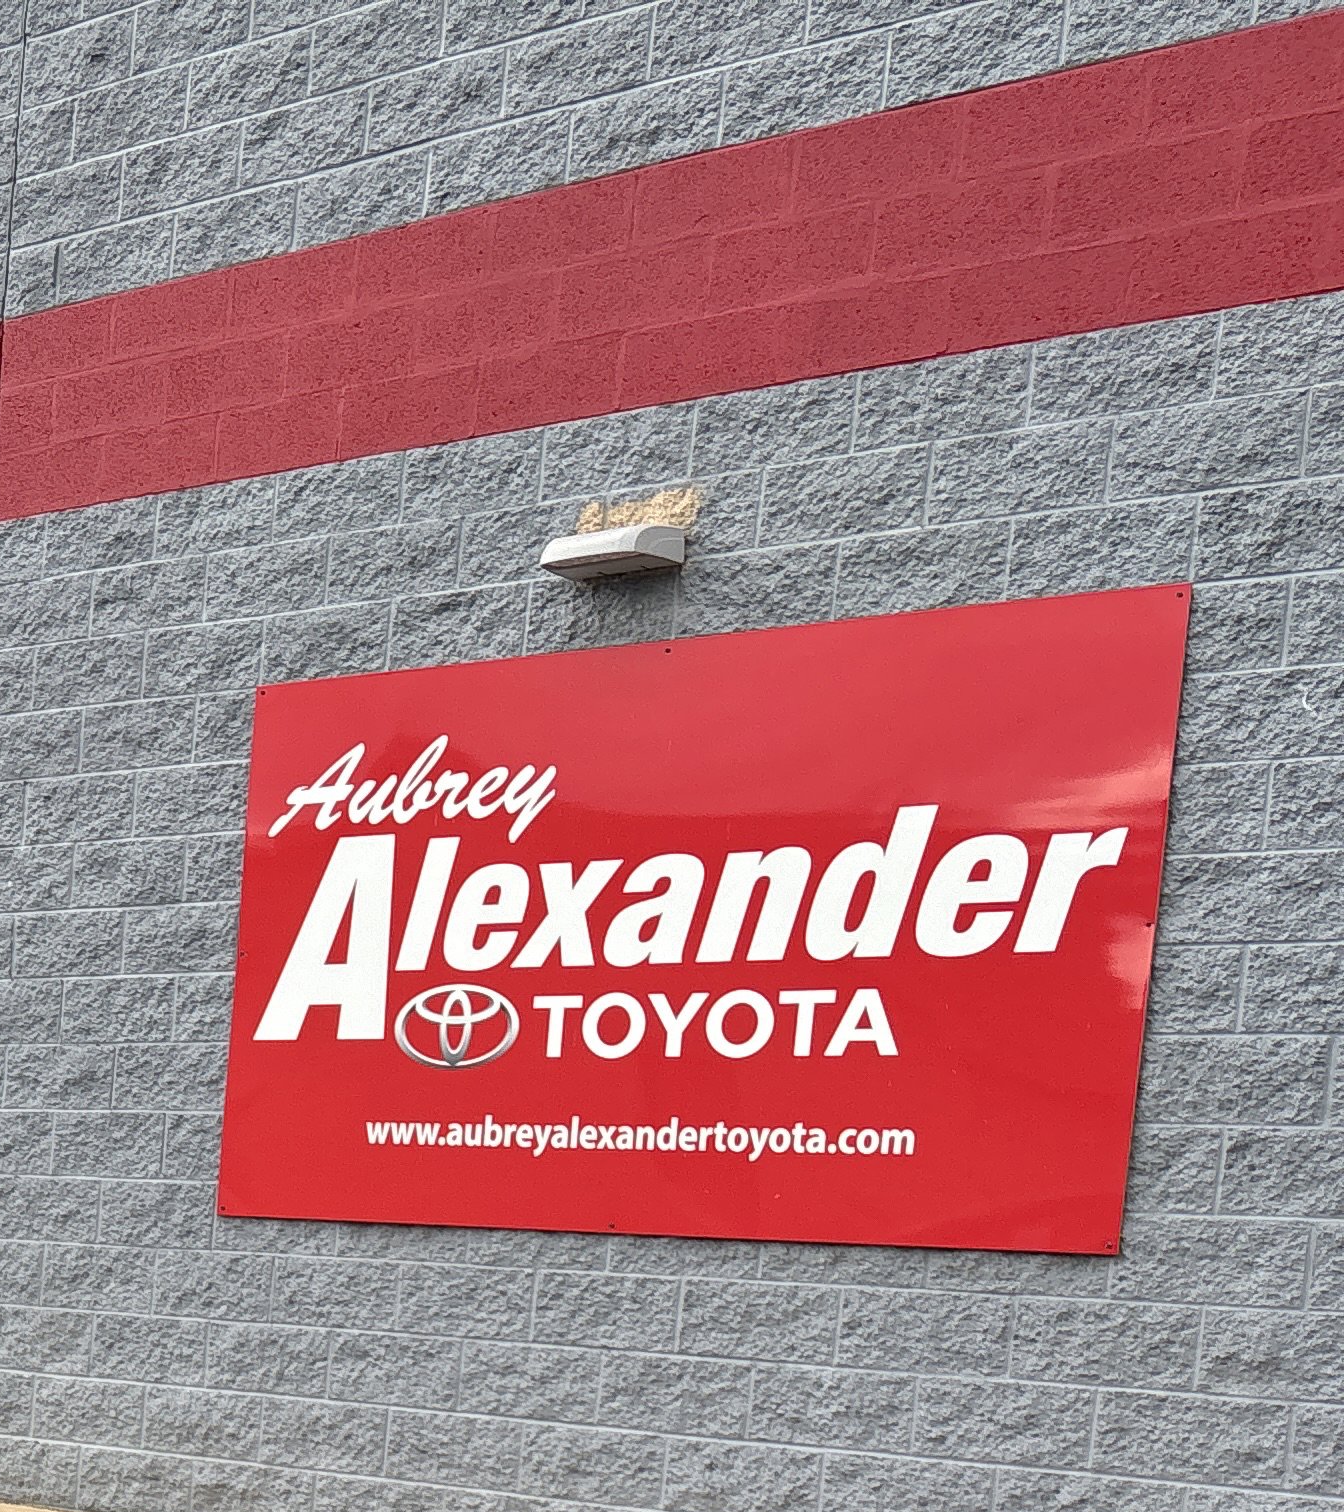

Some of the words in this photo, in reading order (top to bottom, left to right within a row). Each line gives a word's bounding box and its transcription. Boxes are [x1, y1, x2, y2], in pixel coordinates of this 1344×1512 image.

[267, 734, 557, 844] Aubrey
[252, 804, 1129, 1041] Alexander
[532, 988, 899, 1059] TOYOTA
[366, 1114, 915, 1162] www.aubreyalexandertoyota.com
